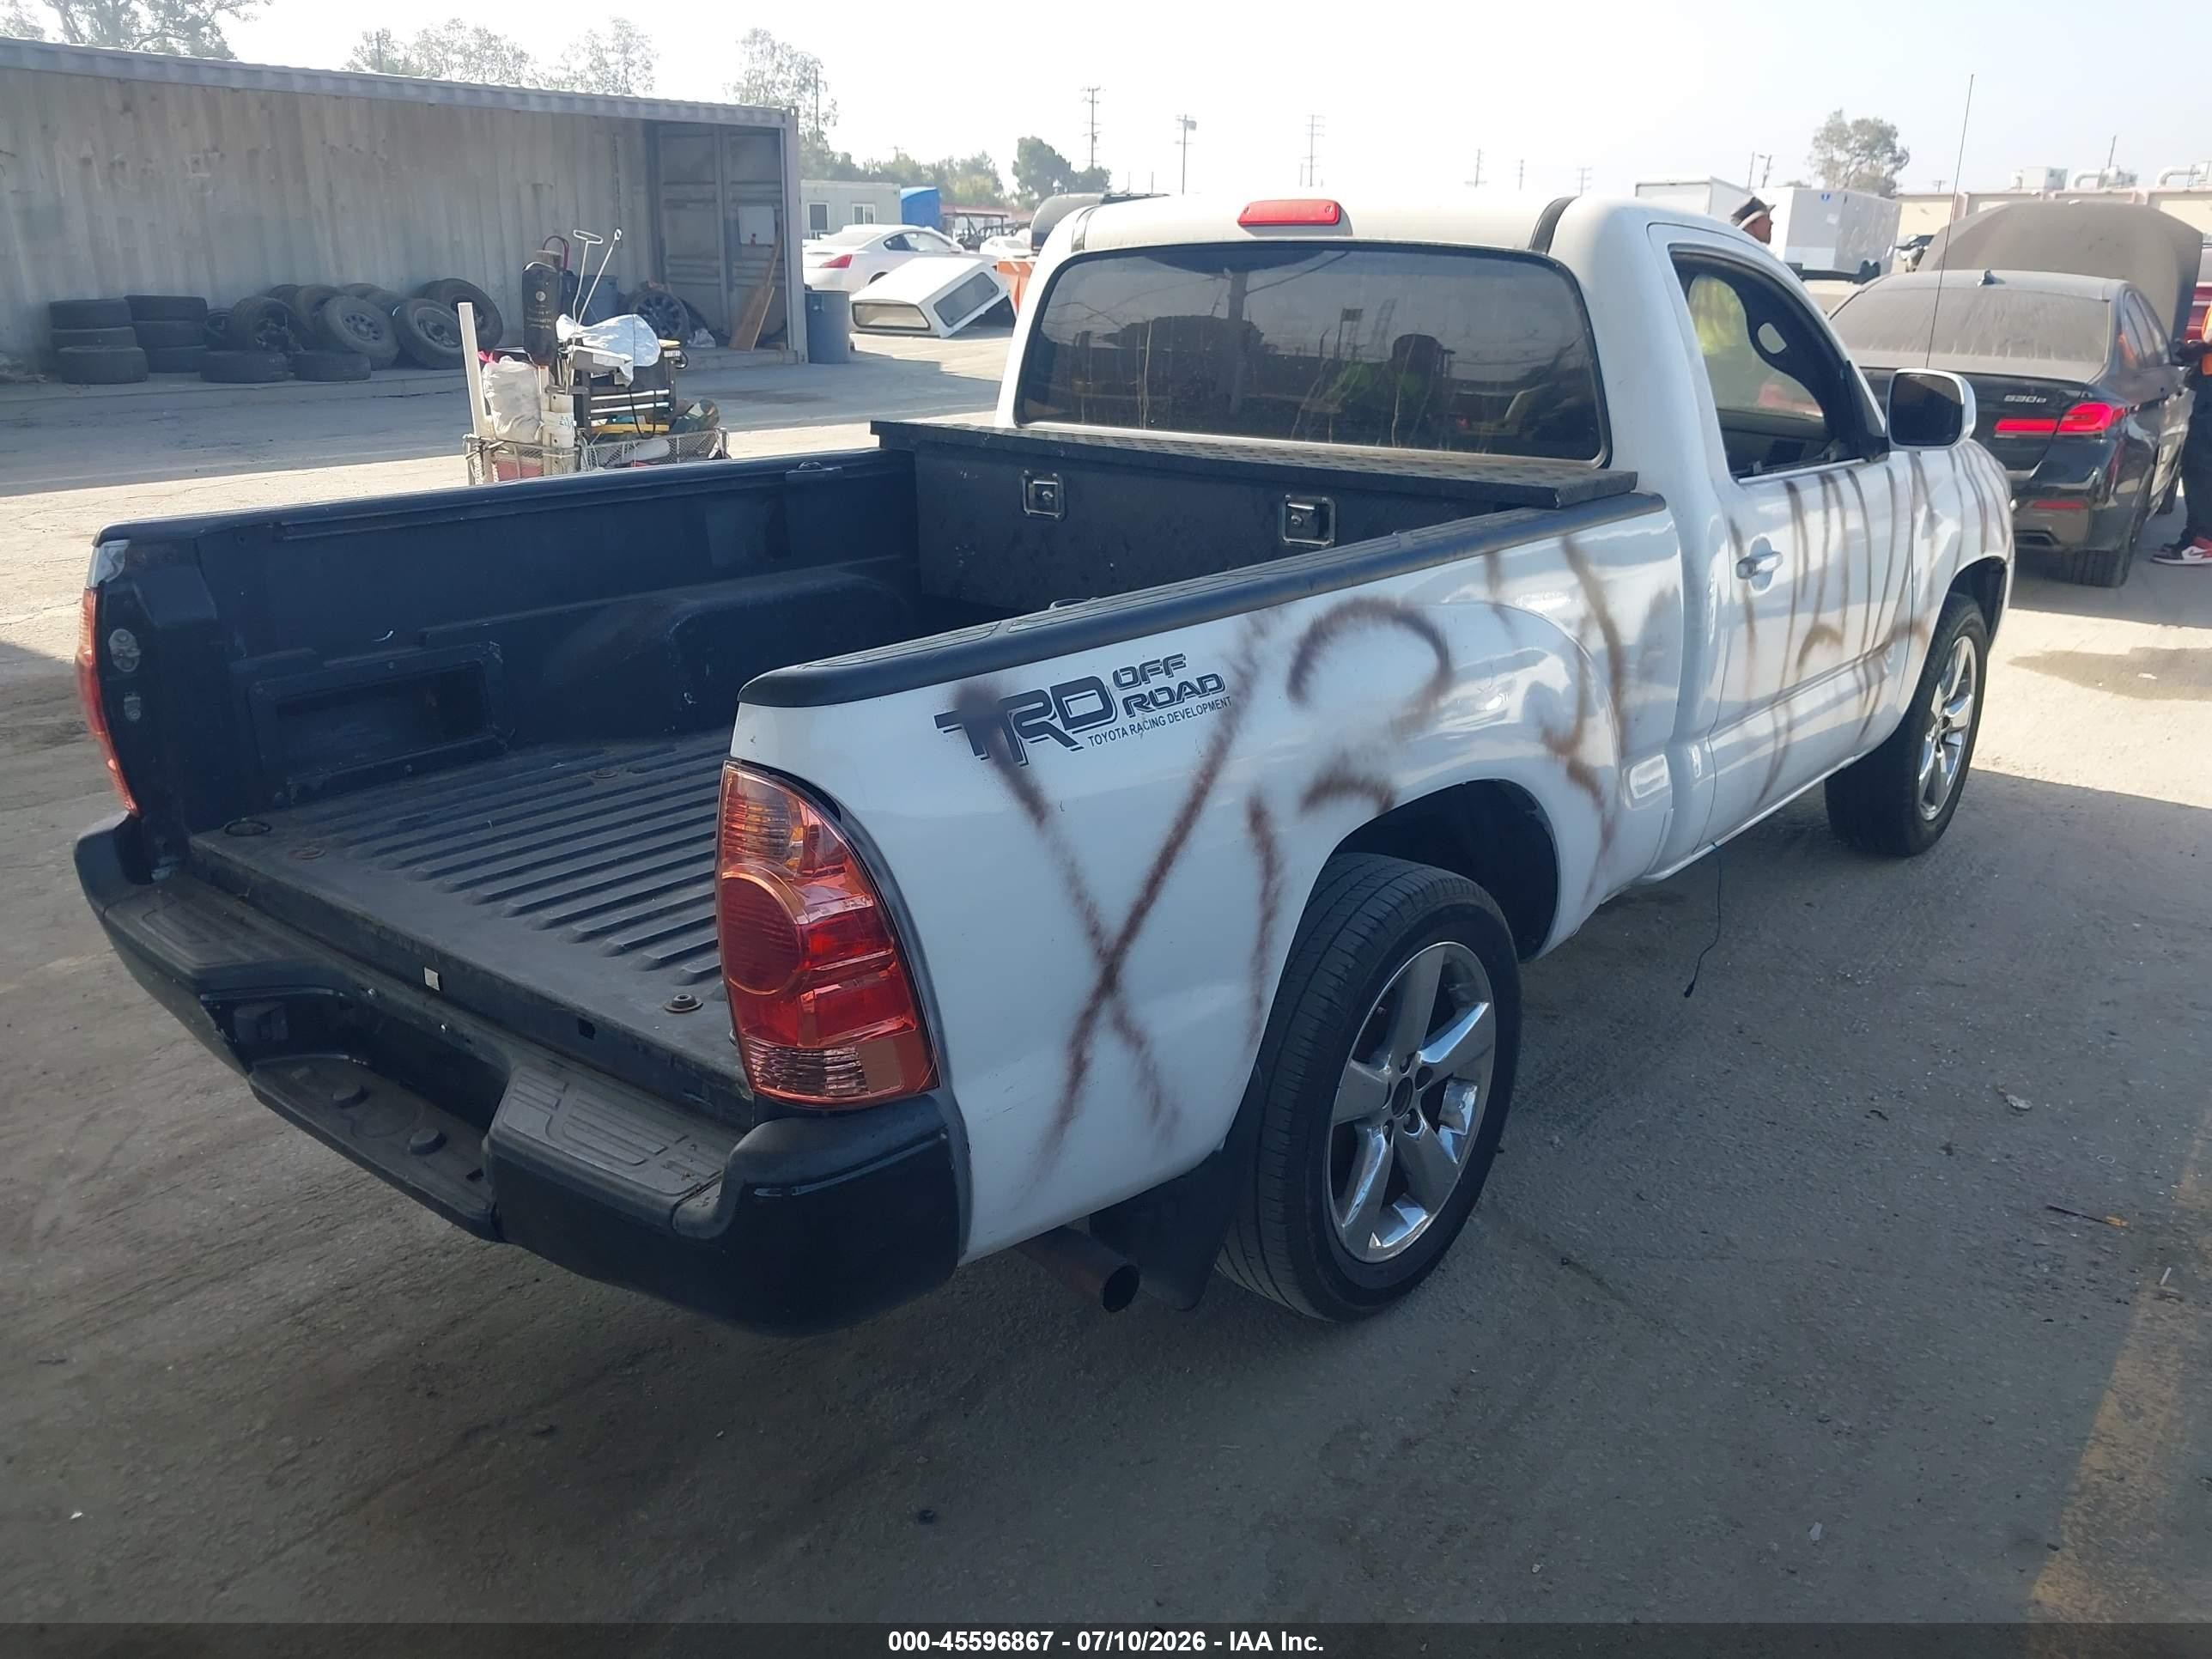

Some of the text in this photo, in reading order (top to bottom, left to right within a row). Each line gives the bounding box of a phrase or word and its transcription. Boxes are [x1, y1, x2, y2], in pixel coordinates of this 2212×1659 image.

[1112, 653, 1187, 690] OFF
[1121, 672, 1226, 718] ROAD
[933, 675, 1119, 767] TRD
[1087, 696, 1232, 748] TOYOTA RACING DEVELOPMENT
